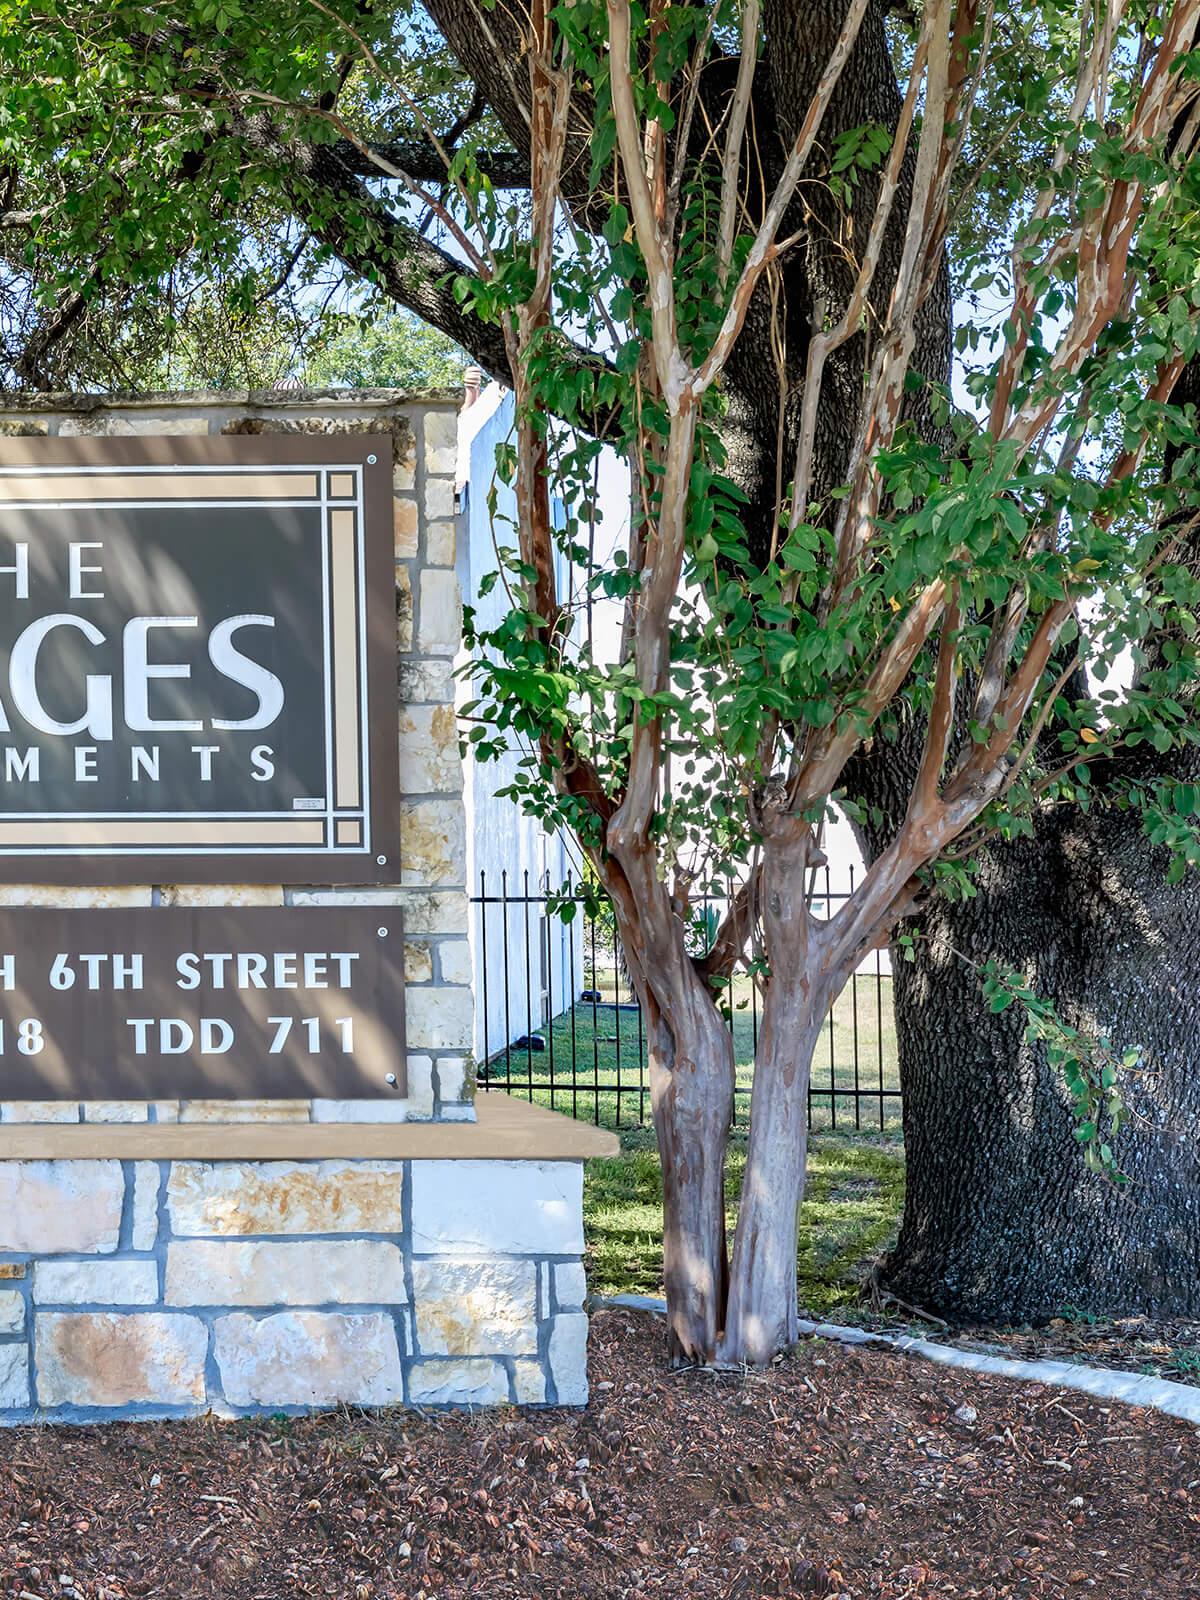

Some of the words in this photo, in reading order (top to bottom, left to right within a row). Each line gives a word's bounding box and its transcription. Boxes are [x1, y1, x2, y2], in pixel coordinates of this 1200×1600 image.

[49, 952, 144, 991] 6TH
[176, 951, 360, 990] STREET
[126, 1018, 235, 1055] TDD
[267, 1017, 354, 1054] 711
